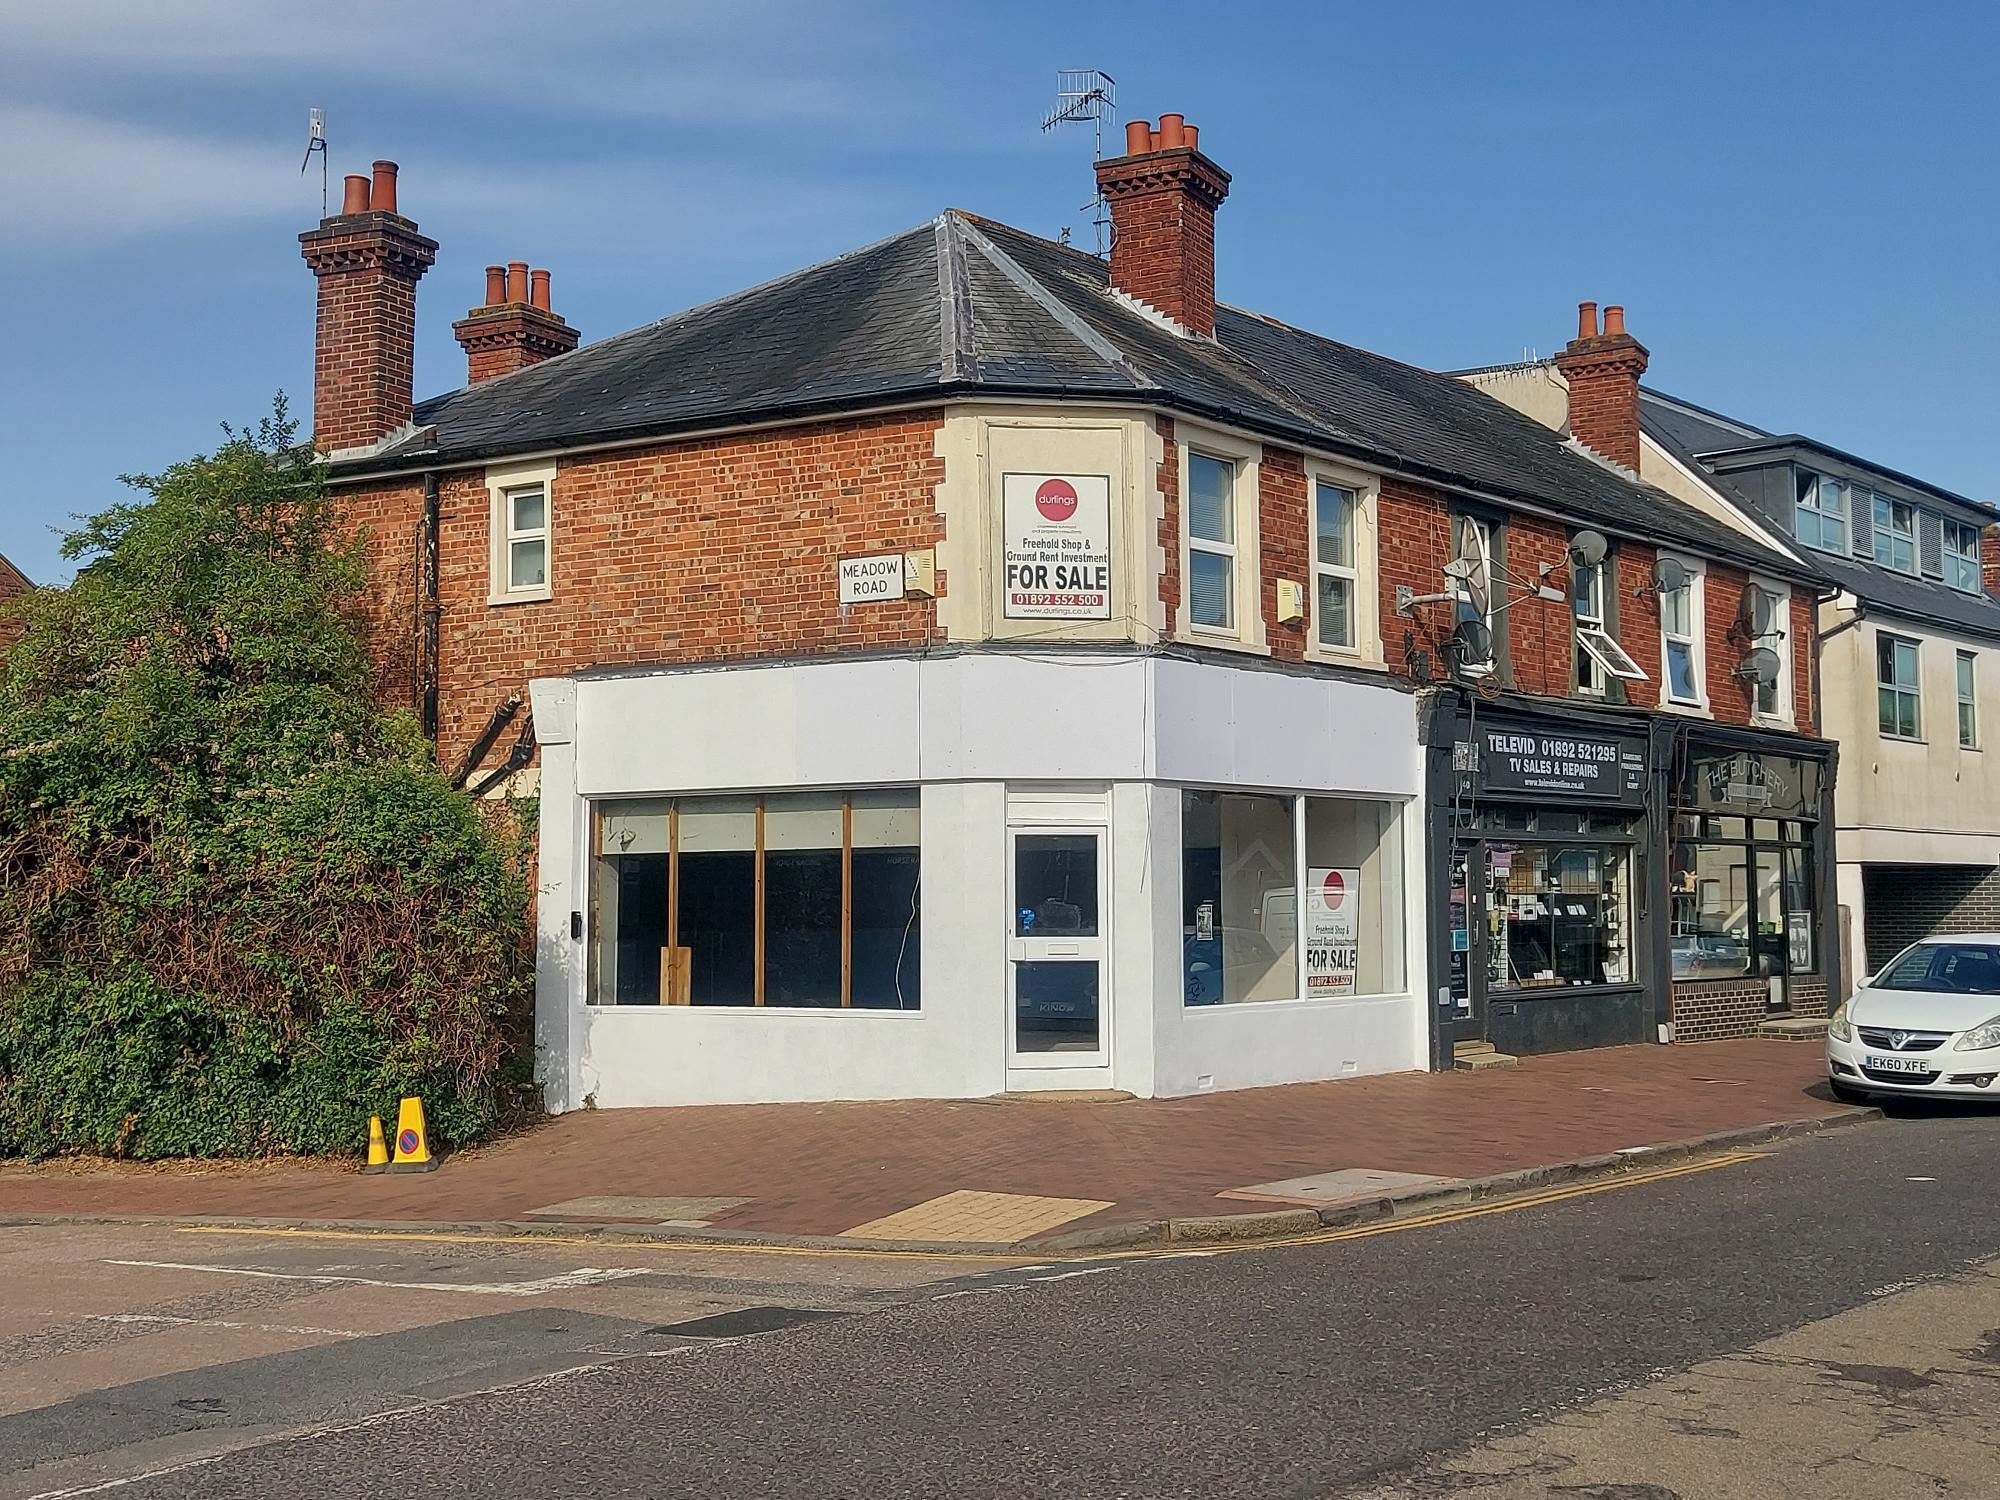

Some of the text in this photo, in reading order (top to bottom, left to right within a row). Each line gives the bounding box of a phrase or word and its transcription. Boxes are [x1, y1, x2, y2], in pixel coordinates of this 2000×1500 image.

[1039, 495, 1075, 506] durlings
[1022, 537, 1091, 552] Freehold Shop &
[1006, 550, 1107, 563] Ground Rent Investment
[843, 561, 898, 579] MEADOW
[1007, 564, 1107, 590] FOR SALE
[853, 580, 888, 595] ROAD
[1016, 594, 1098, 605] 01892 552 500
[1023, 607, 1092, 615] www.durlings.co.uk
[1487, 734, 1536, 755] TELEVID
[1541, 739, 1575, 759] 01892
[1578, 743, 1616, 762] 521295
[1509, 757, 1598, 778] TV SALES & REPAIRS
[1705, 762, 1729, 790] THE
[1730, 759, 1789, 798] BUTCHERY
[1307, 949, 1356, 971] FOR SALE
[1872, 1057, 1927, 1073] EK60 XFE
